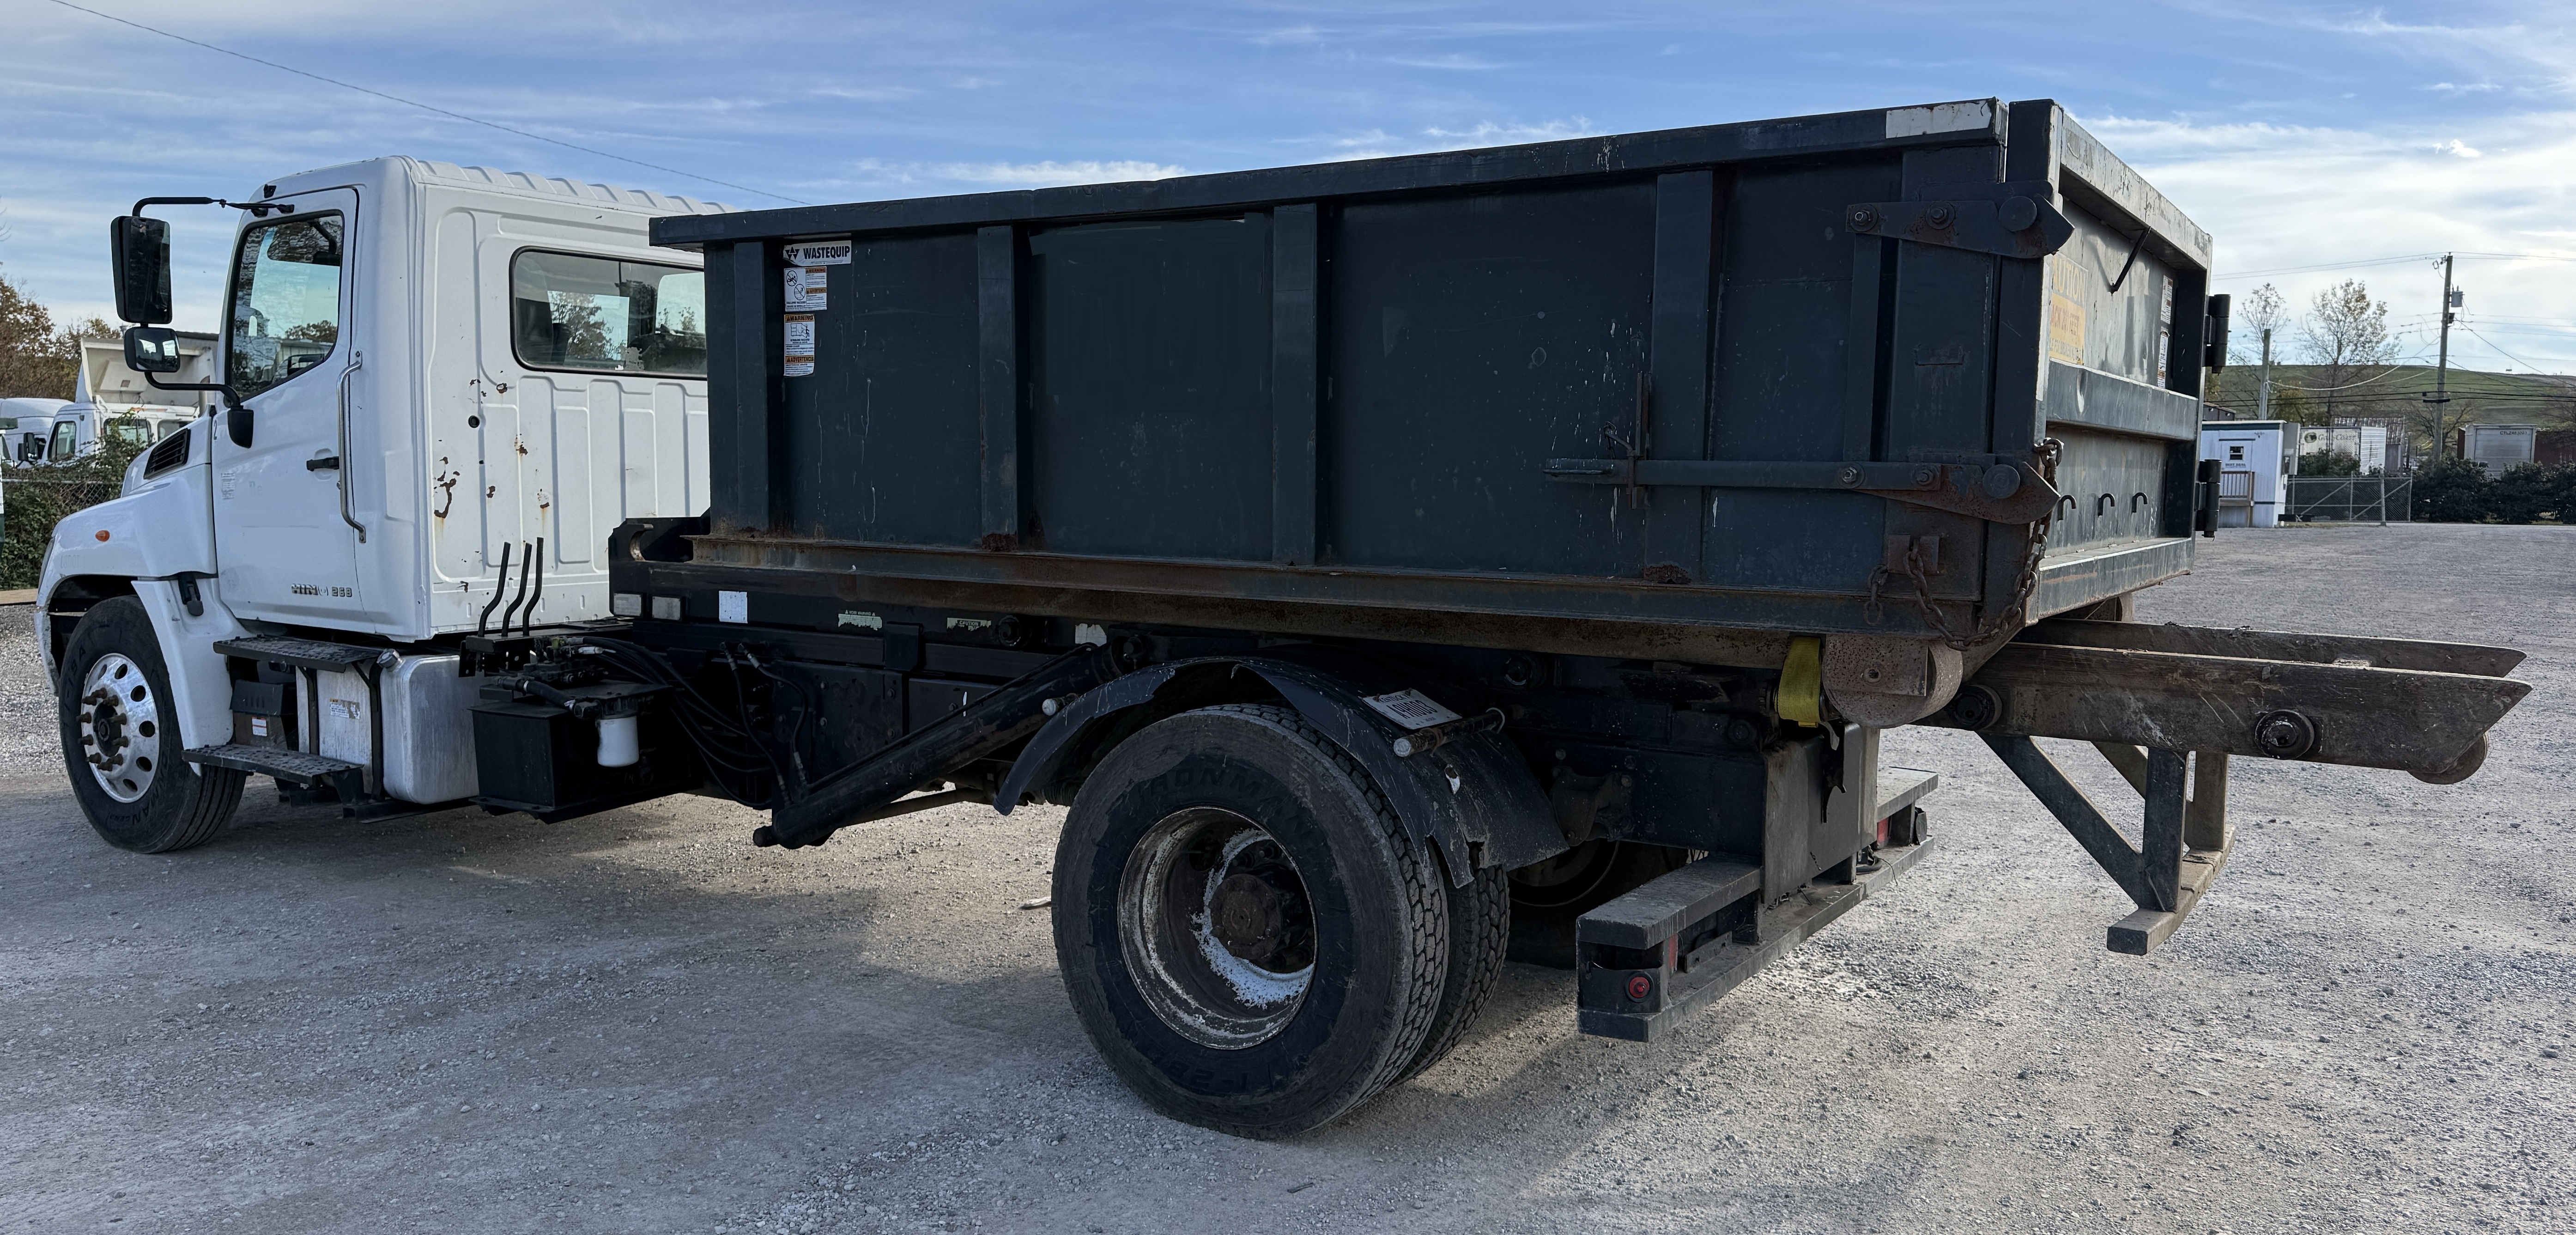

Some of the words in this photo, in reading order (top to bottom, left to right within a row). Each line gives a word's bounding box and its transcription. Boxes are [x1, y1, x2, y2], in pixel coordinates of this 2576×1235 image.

[803, 246, 850, 259] WASTEQUIP
[2053, 255, 2085, 305] AUTION
[2051, 303, 2061, 329] ACK
[332, 586, 352, 597] 268
[1386, 700, 1437, 719] A9H003
